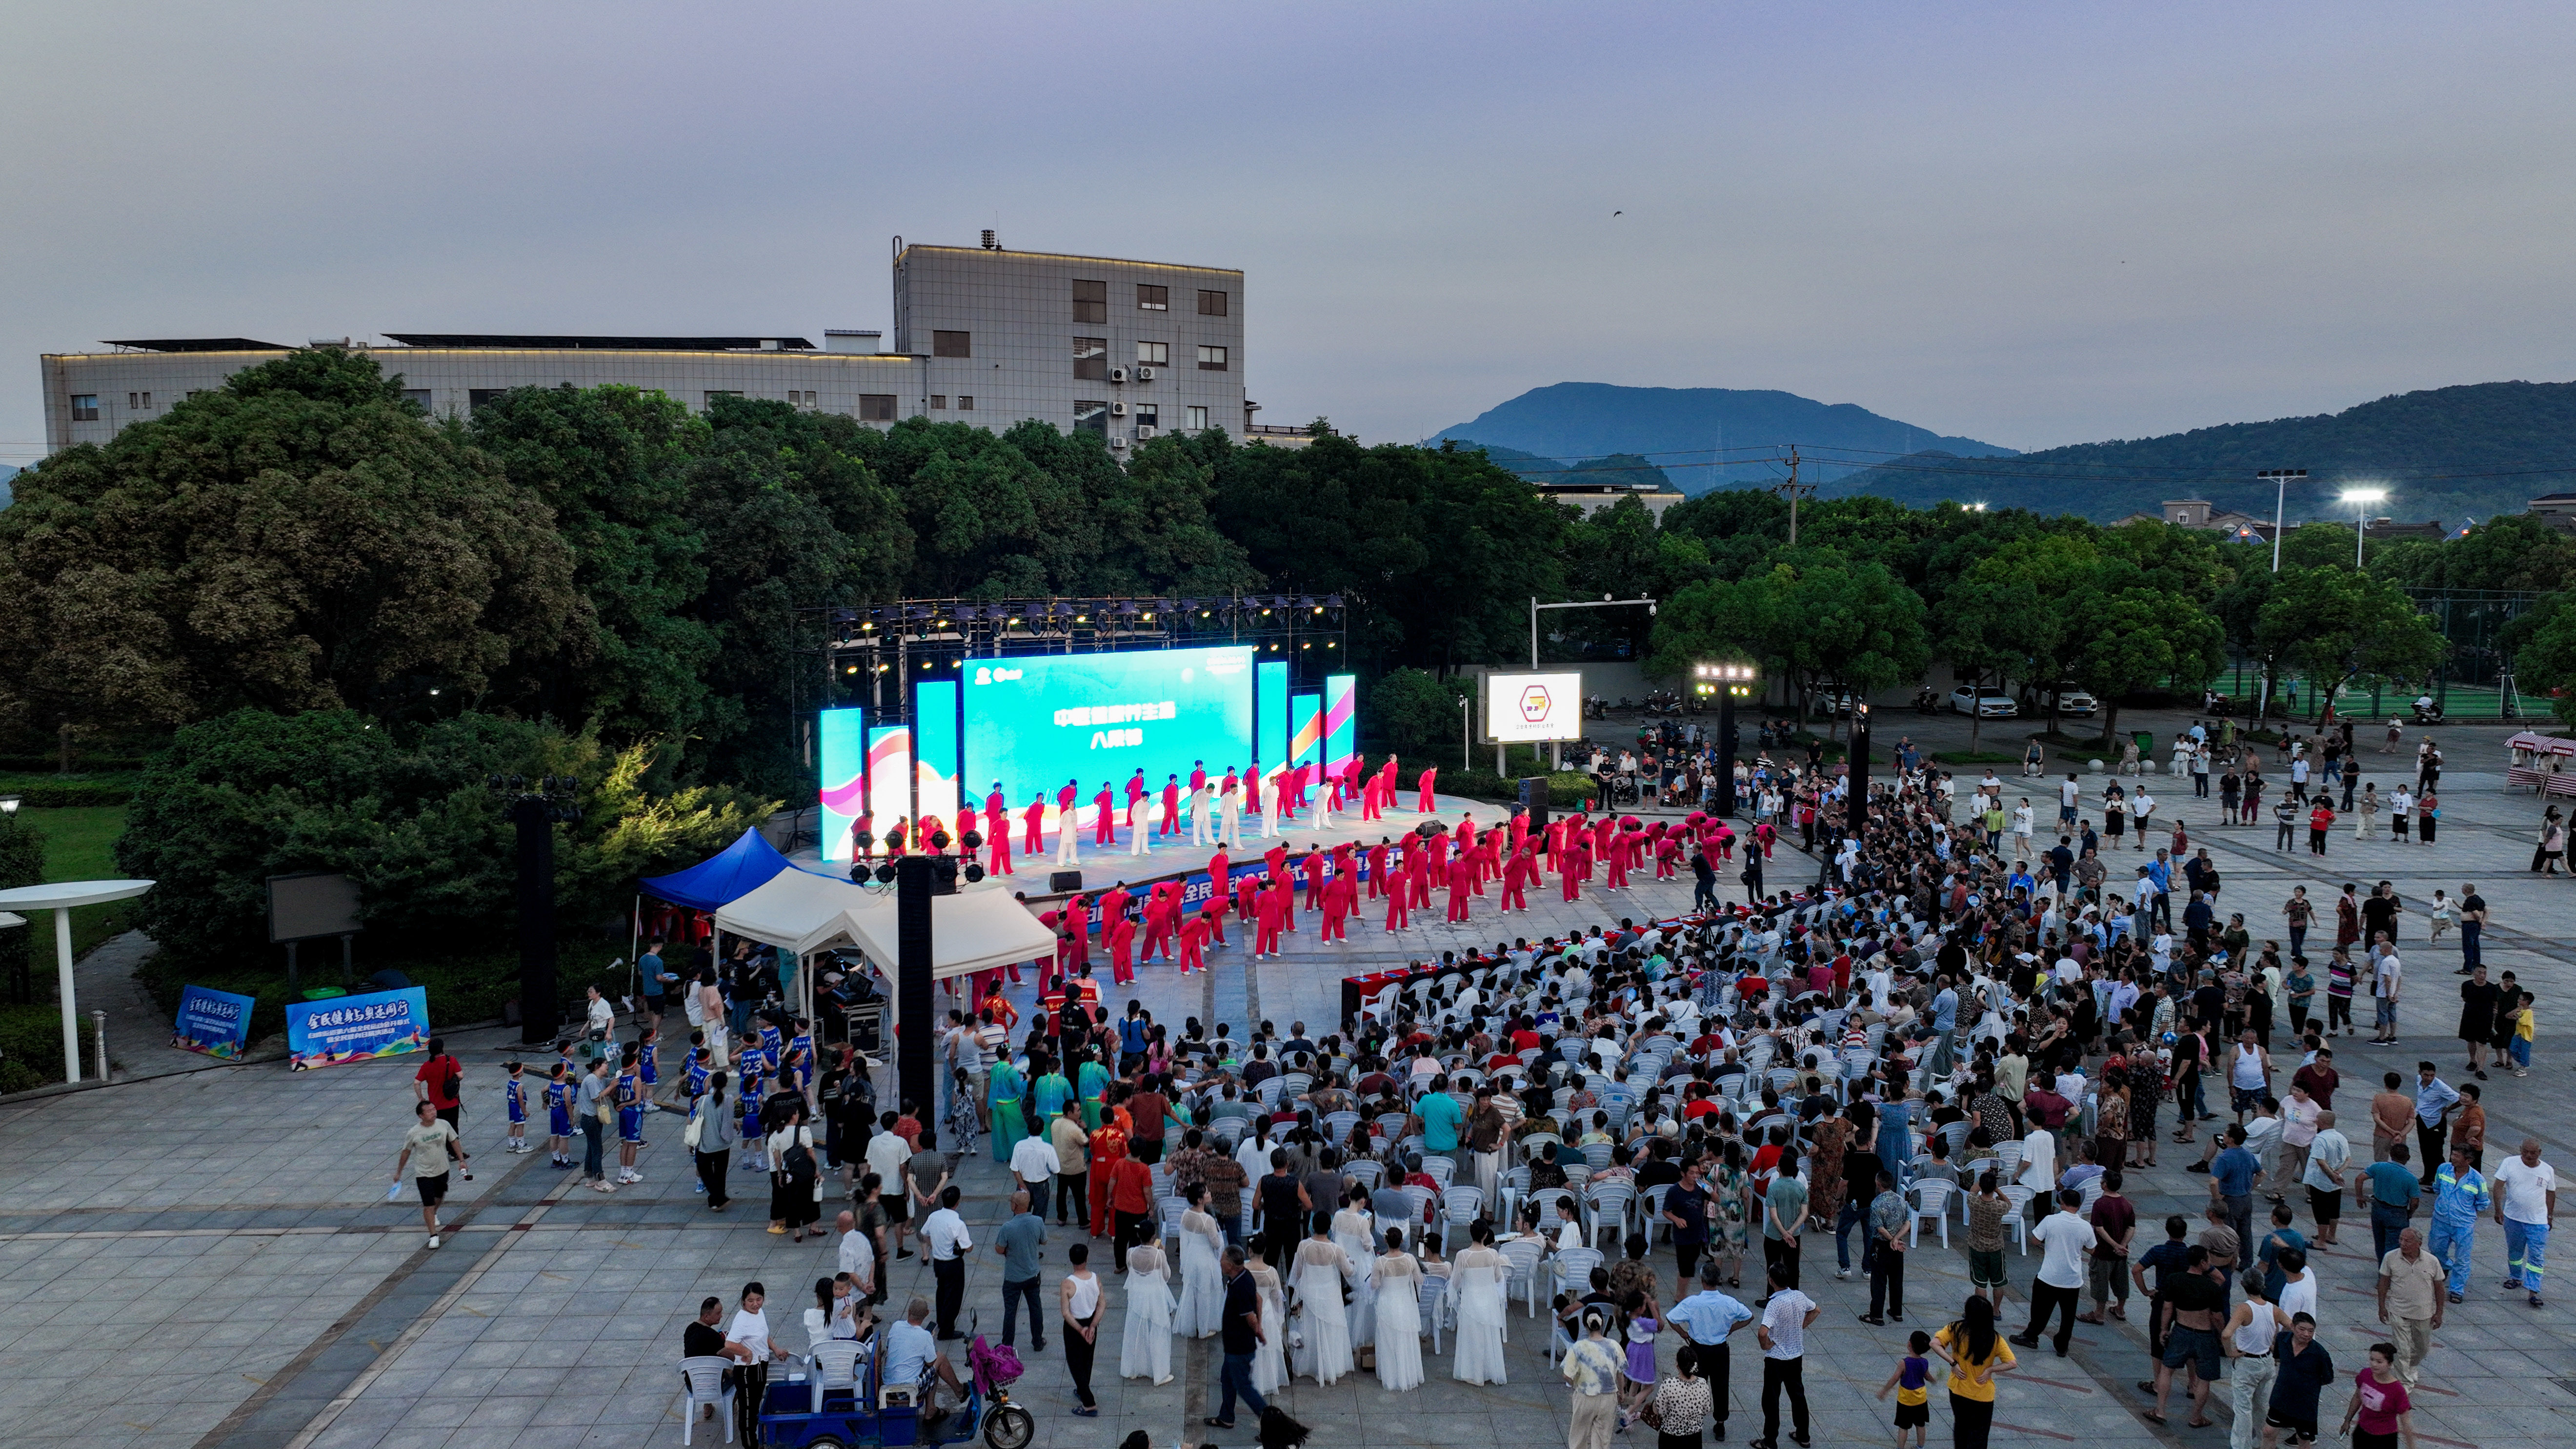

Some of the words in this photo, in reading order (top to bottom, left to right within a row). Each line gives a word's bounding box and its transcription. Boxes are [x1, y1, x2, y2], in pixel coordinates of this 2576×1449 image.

[307, 1001, 409, 1029] 全民健身与奥运同行
[742, 1060, 763, 1074] 23
[549, 1094, 561, 1108] 15
[619, 1087, 630, 1102] 10
